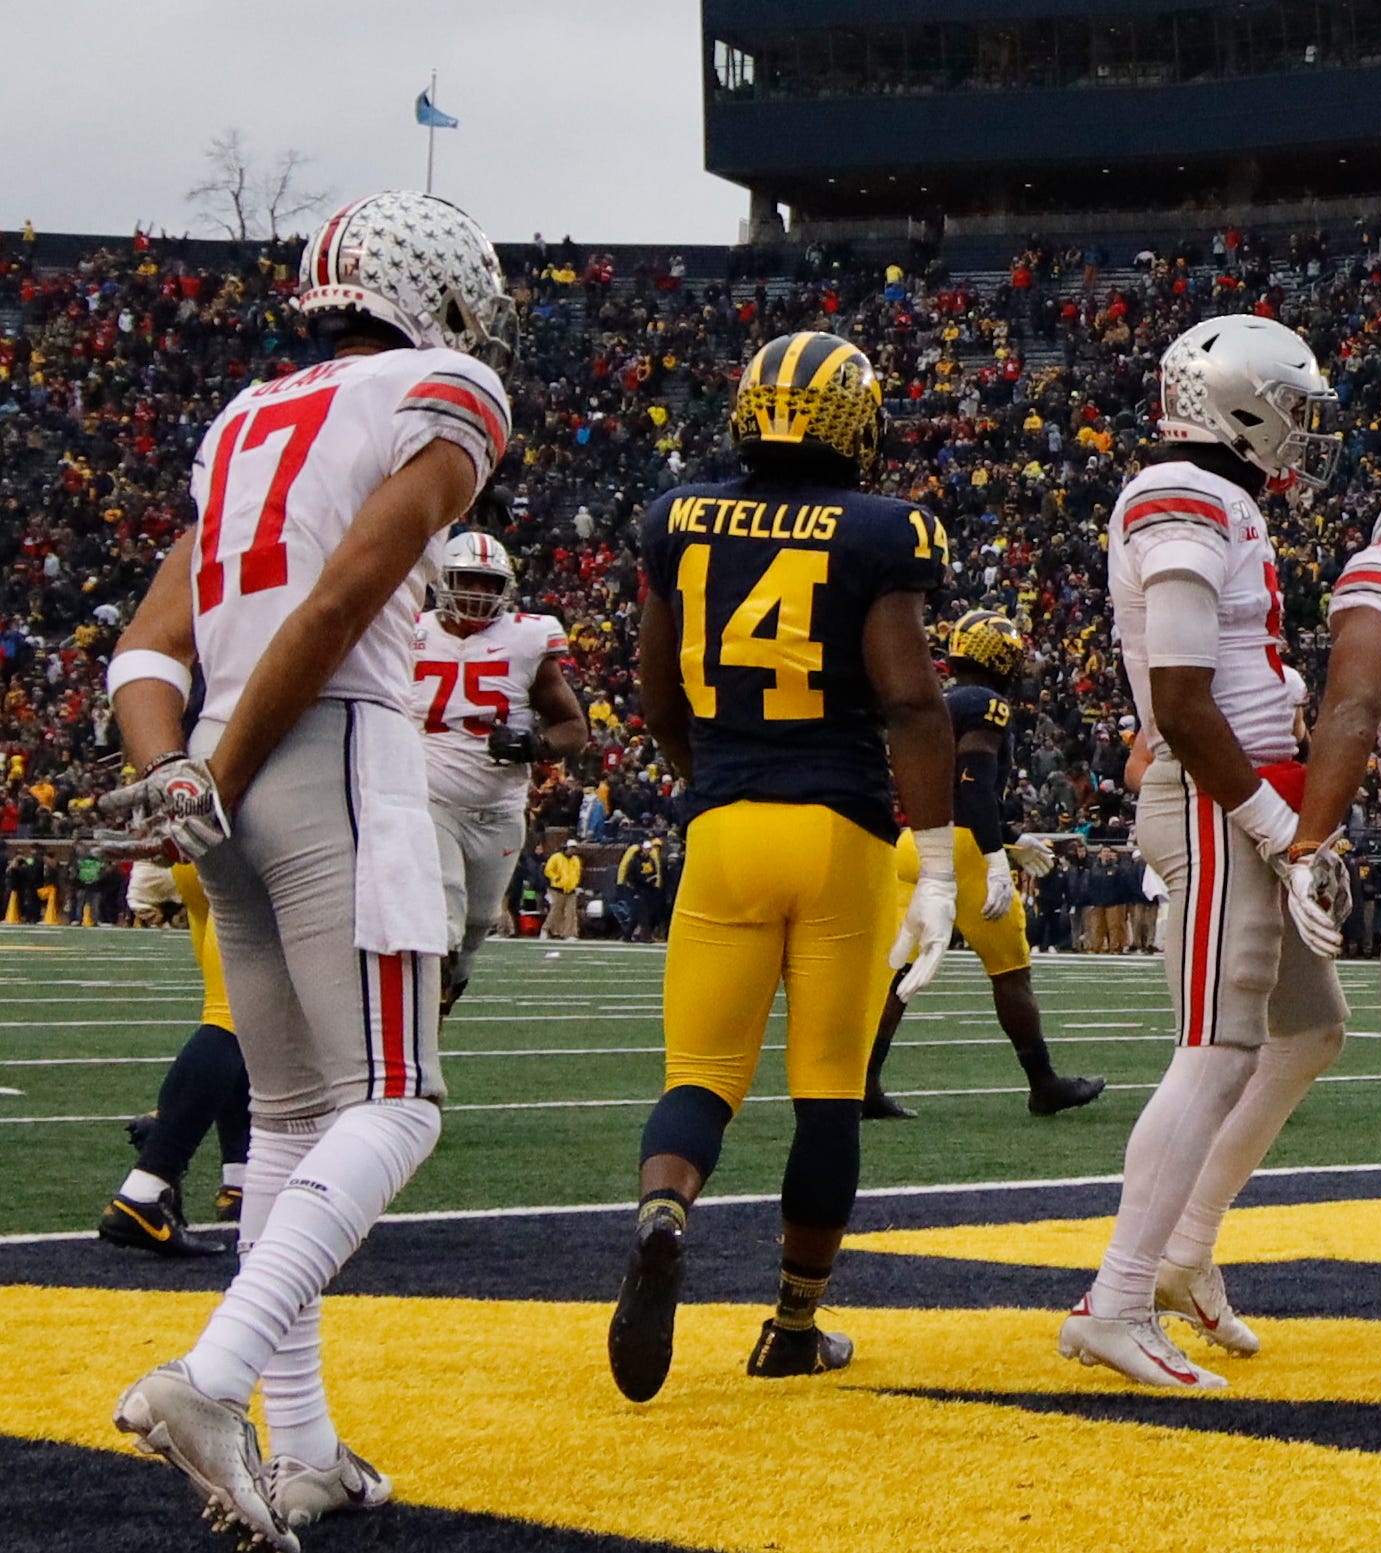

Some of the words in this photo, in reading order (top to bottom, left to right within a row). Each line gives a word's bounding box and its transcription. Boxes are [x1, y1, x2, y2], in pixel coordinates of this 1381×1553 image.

[195, 383, 341, 616] 17
[668, 496, 844, 541] METELLUS
[908, 510, 950, 567] 14
[676, 543, 830, 721] 14
[414, 660, 510, 736] 75
[983, 698, 1010, 728] 19
